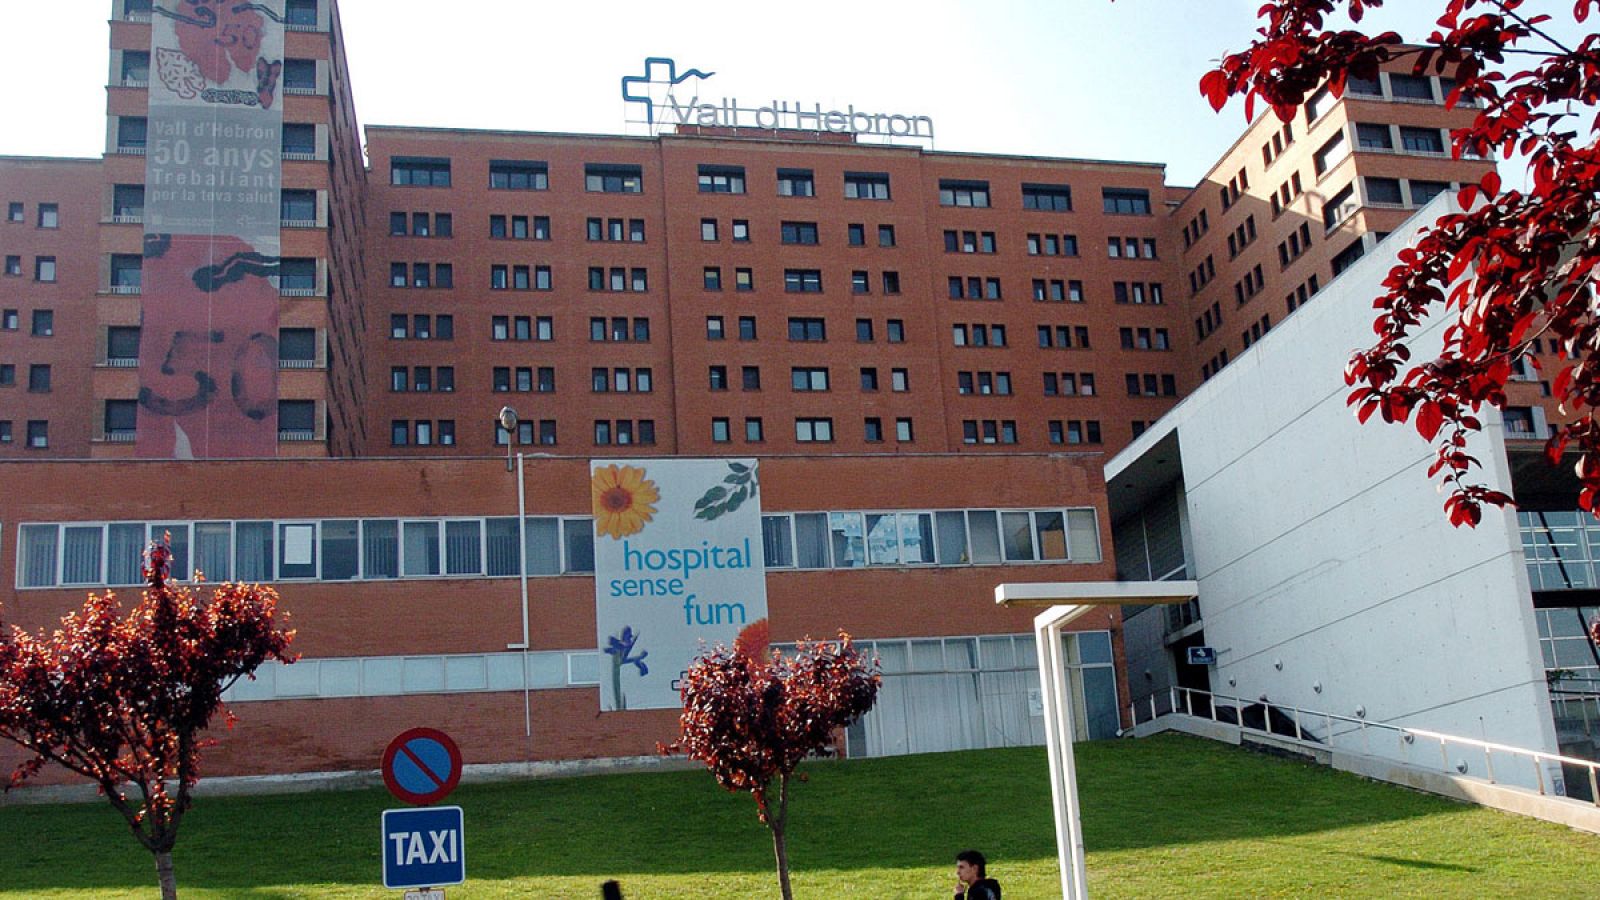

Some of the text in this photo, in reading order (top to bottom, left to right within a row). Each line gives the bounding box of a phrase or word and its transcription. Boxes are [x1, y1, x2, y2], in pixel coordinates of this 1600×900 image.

[154, 121, 275, 139] Vall d'Hebron
[668, 94, 934, 136] Vall d'Hebron
[153, 139, 275, 173] 50 anys
[152, 167, 275, 188] Treballant
[182, 188, 196, 201] la
[237, 190, 274, 203] salut
[138, 331, 278, 421] 50
[624, 537, 751, 579] hospital
[610, 577, 684, 597] sense
[683, 594, 746, 626] fum
[389, 829, 457, 866] TAXI
